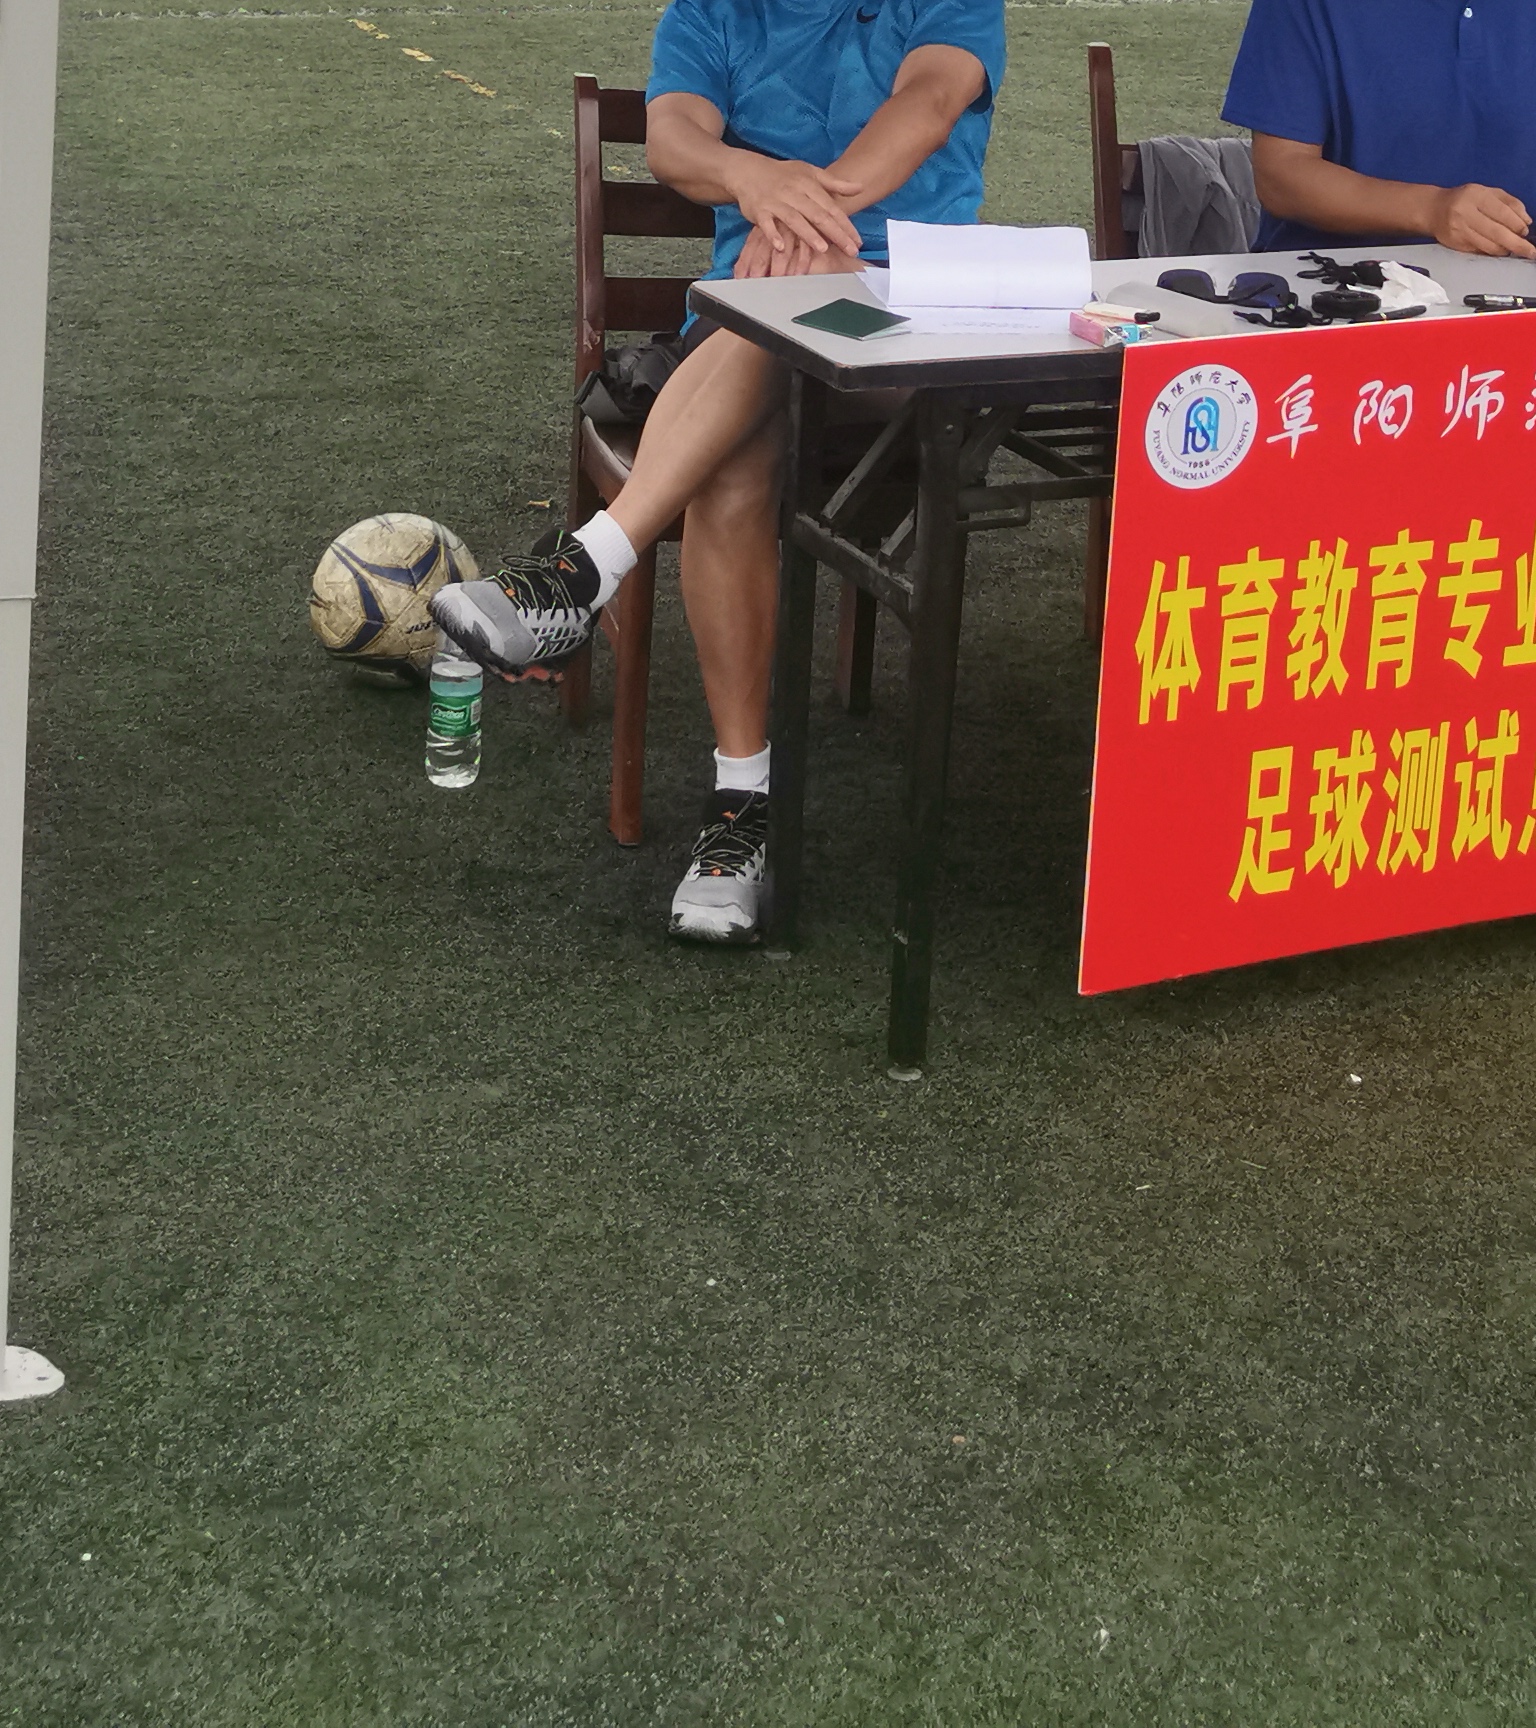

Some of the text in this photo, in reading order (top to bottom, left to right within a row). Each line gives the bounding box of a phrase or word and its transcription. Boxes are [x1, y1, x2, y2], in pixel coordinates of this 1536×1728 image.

[1152, 420, 1252, 481] FUYANG NORMAL UNIVERSITY
